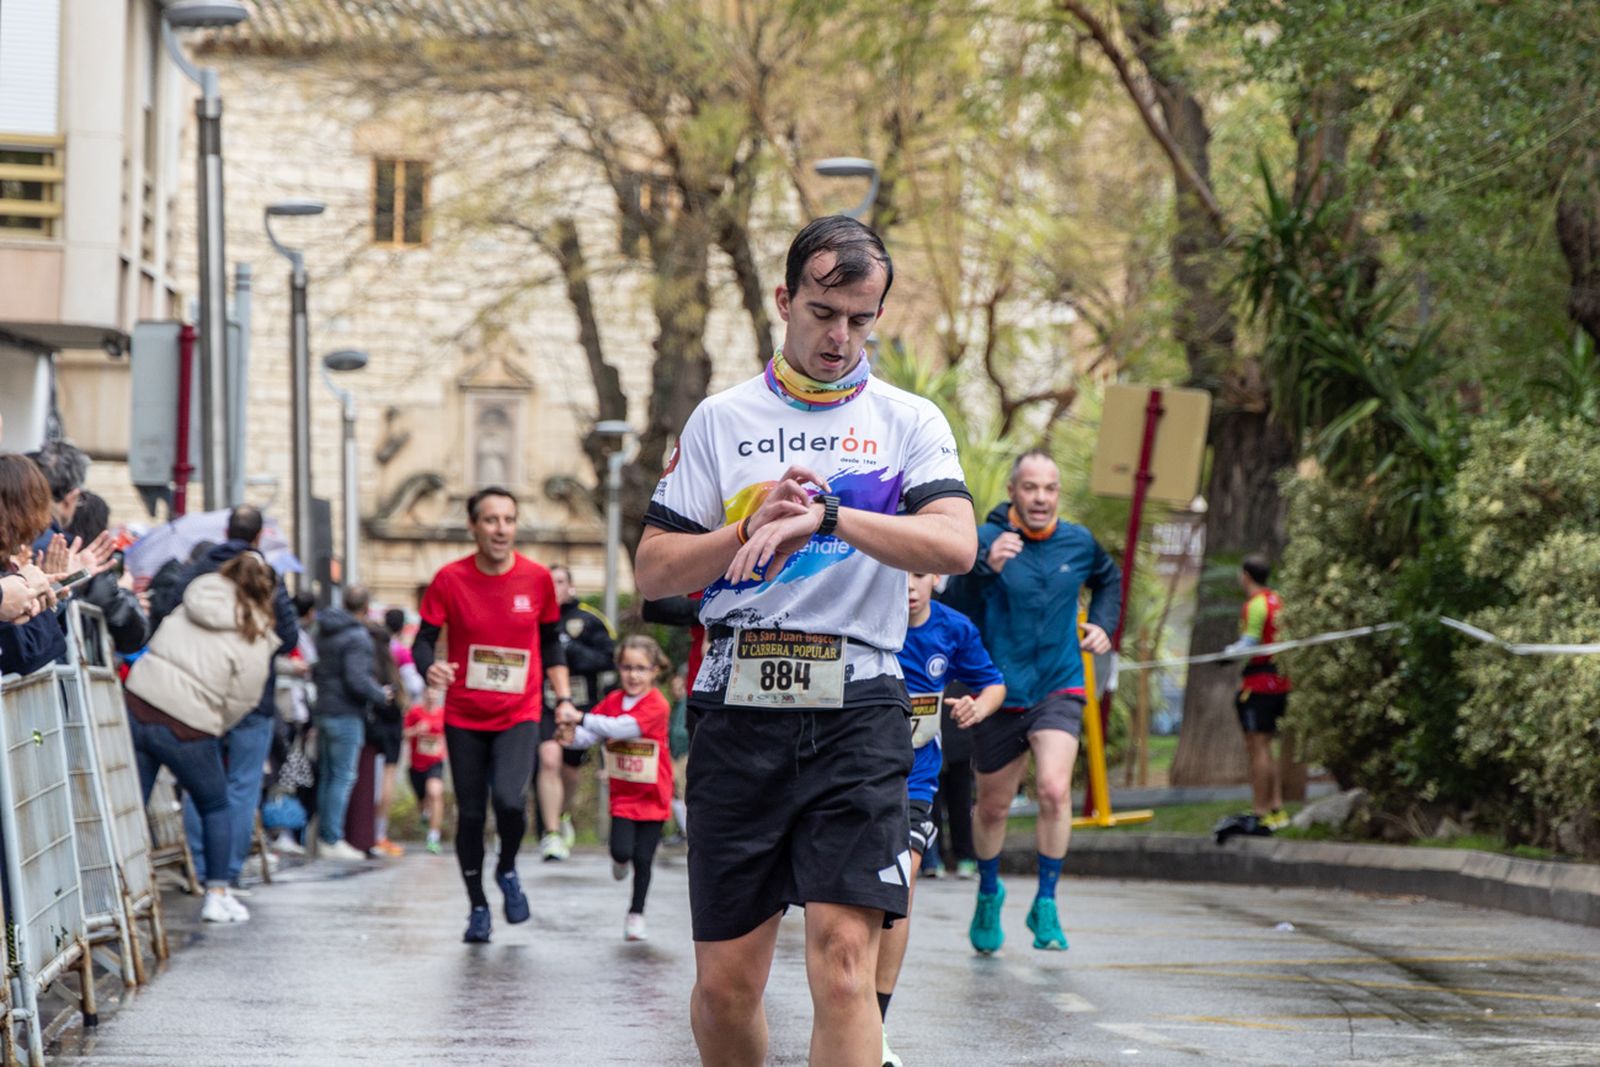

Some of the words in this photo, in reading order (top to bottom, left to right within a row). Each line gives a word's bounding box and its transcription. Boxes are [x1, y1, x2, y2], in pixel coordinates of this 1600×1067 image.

[738, 427, 877, 462] calderón
[760, 631, 776, 641] San
[779, 631, 802, 642] Juan
[741, 645, 748, 656] V
[750, 643, 790, 656] CARRERA
[793, 645, 837, 658] POPULAR
[760, 661, 811, 691] 884
